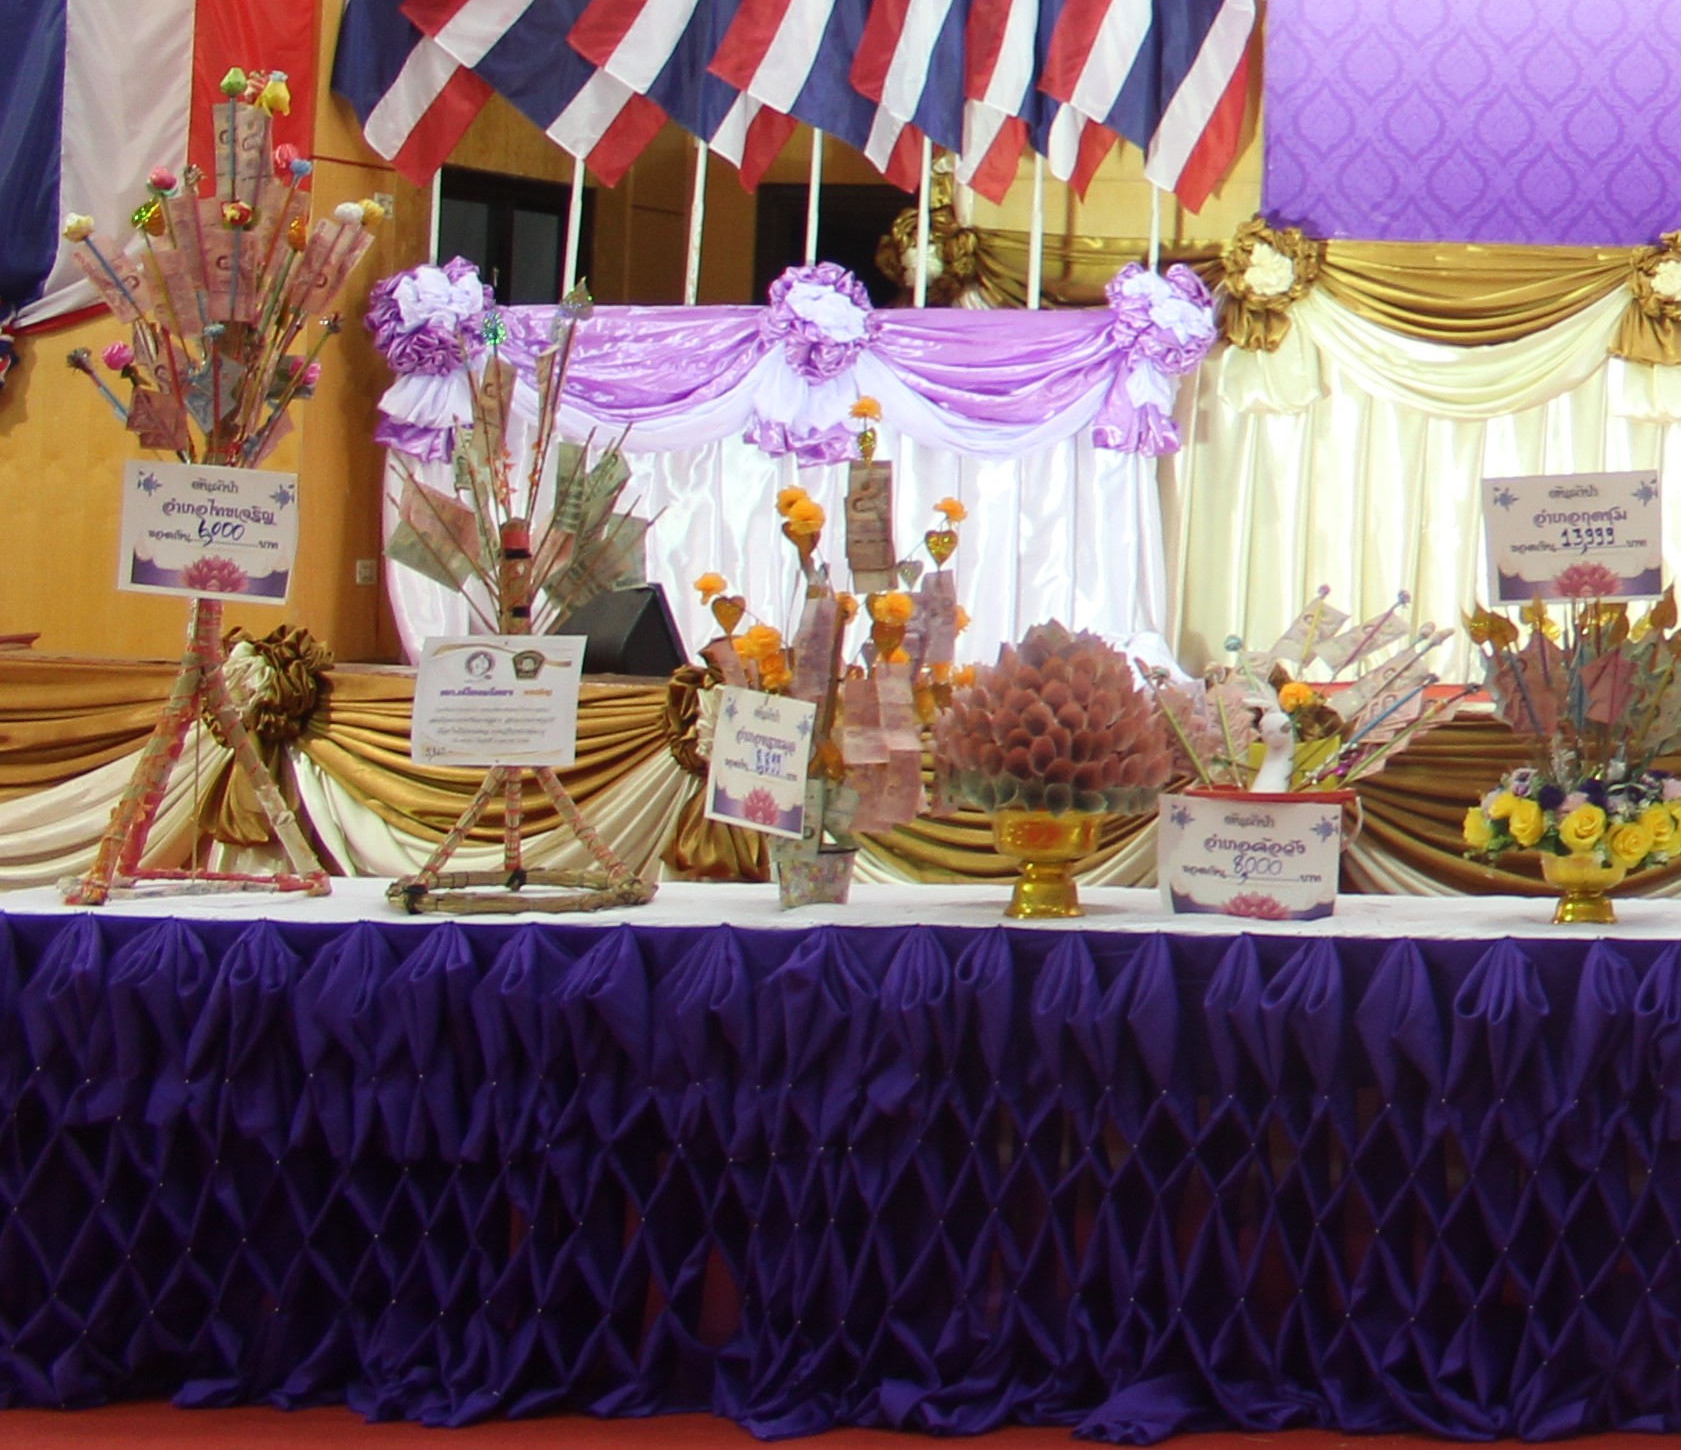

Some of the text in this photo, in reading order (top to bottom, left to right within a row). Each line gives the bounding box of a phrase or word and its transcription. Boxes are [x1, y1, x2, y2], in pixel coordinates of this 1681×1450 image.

[162, 498, 277, 526] อำเภอไทยเจริญ
[1560, 526, 1615, 555] 13,999
